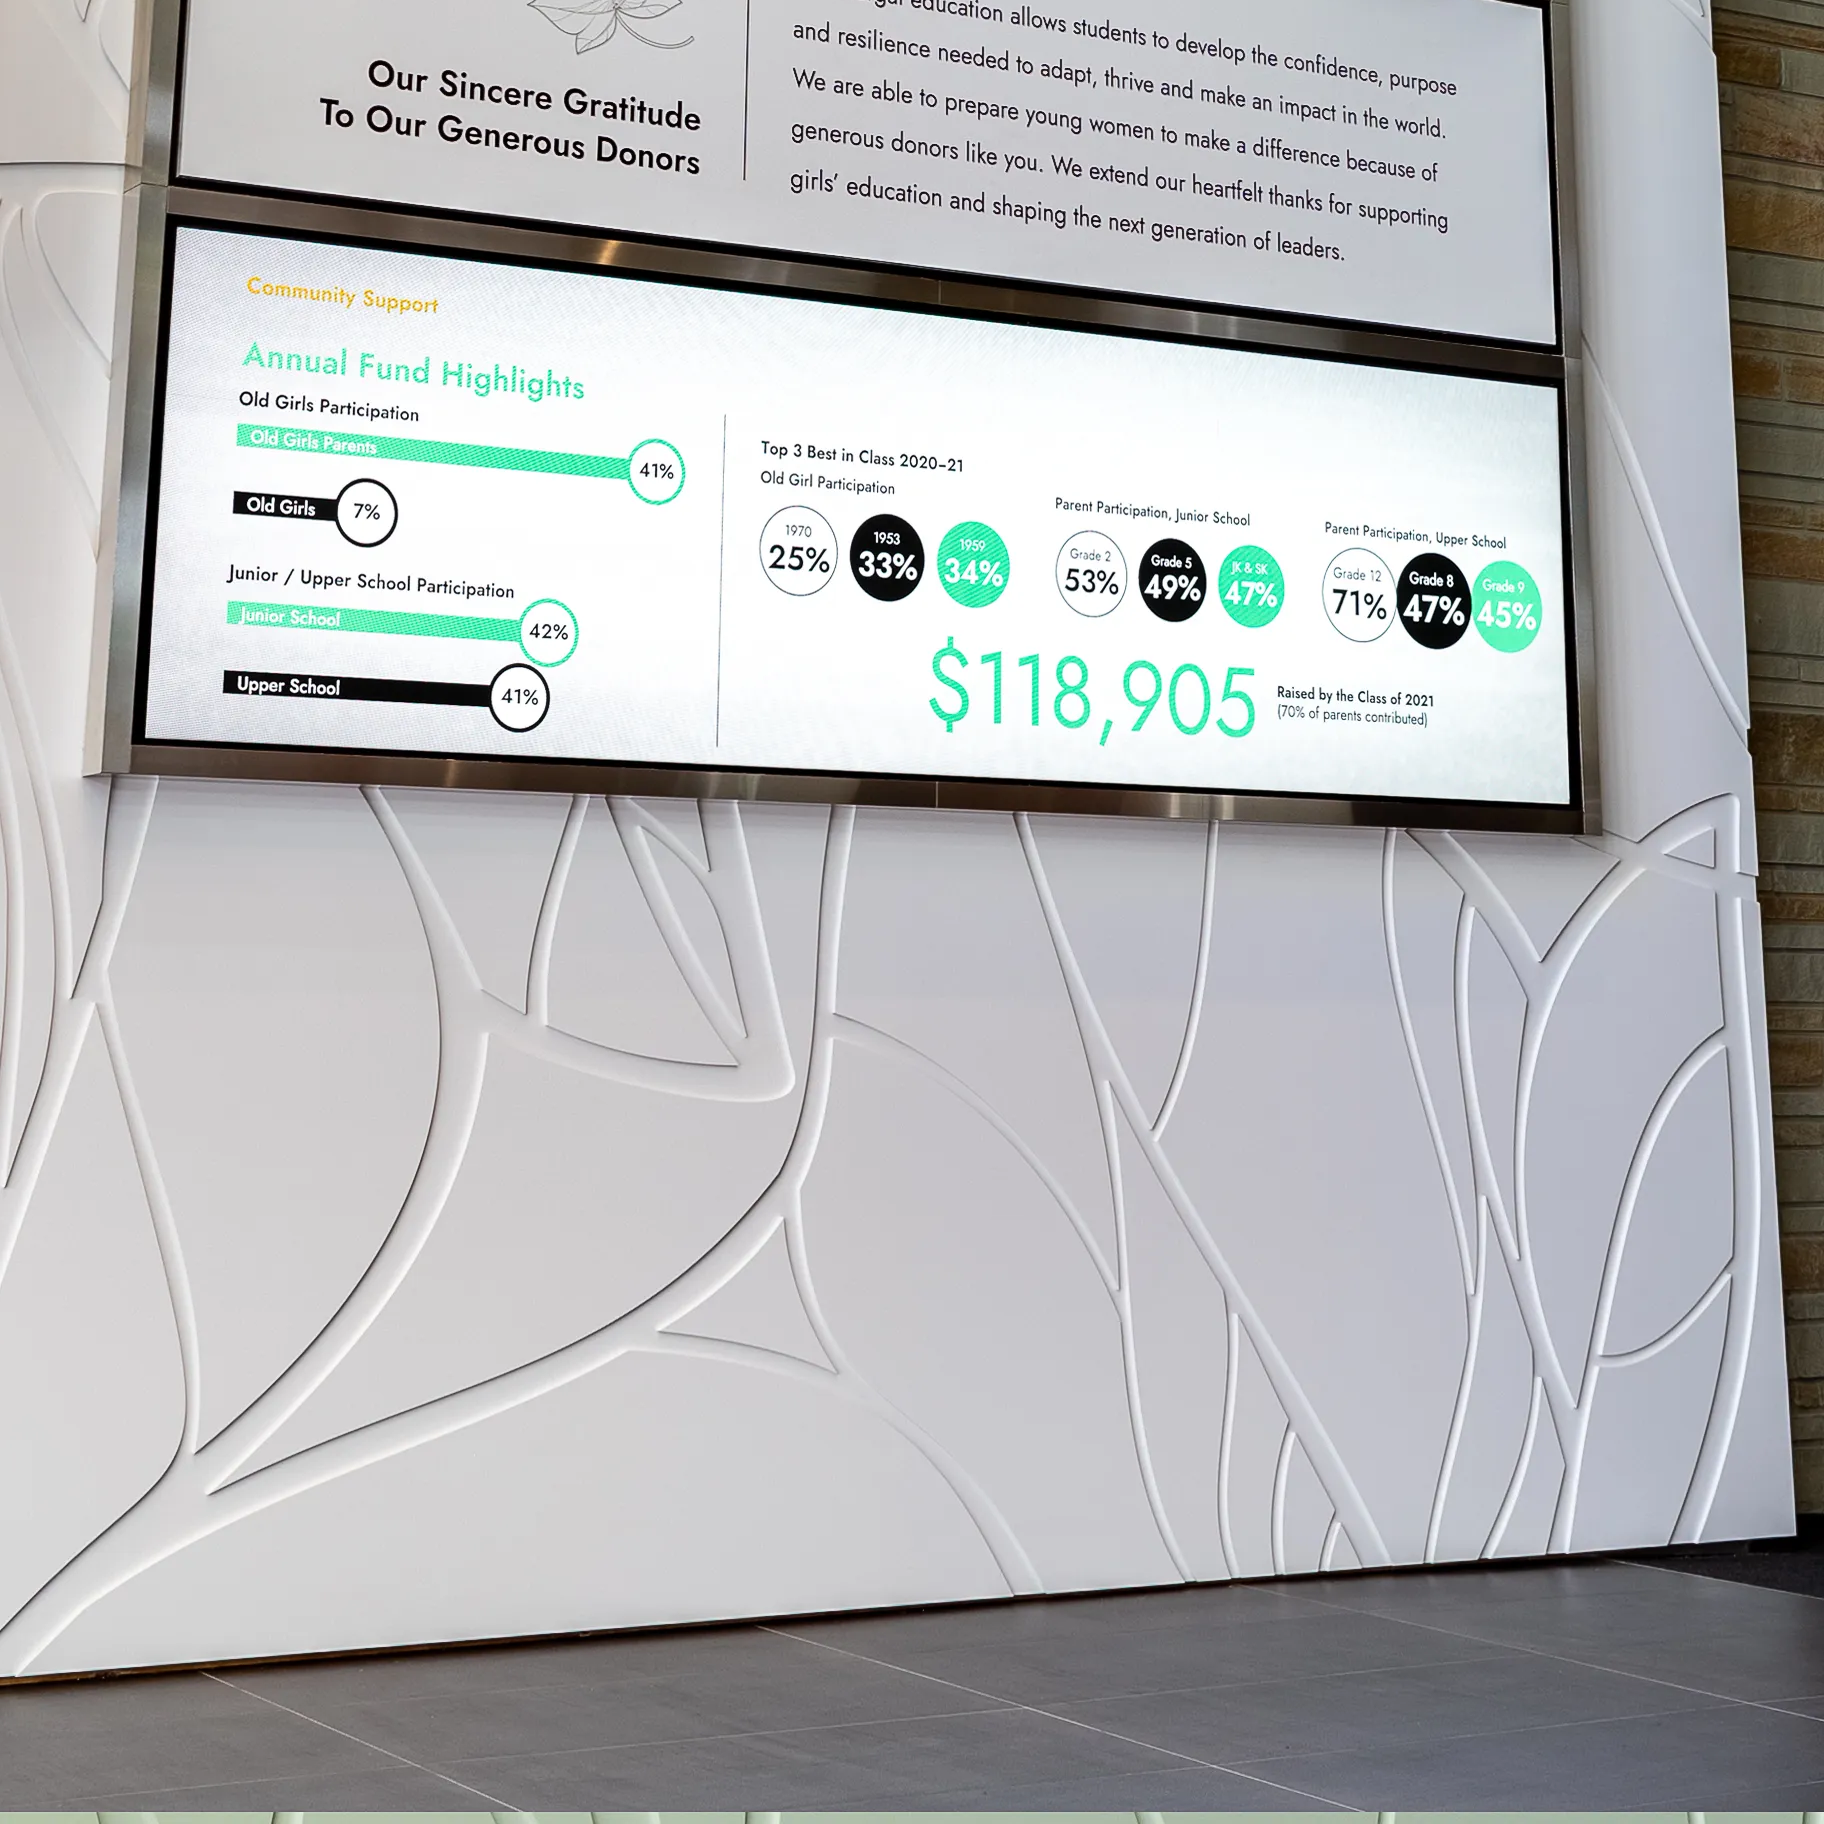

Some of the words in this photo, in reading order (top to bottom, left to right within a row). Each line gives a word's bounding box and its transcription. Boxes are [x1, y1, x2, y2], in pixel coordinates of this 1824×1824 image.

[1011, 6, 1066, 32] allows
[1073, 20, 1146, 45] students
[1152, 31, 1169, 49] to
[1176, 32, 1245, 65] develop
[1252, 45, 1277, 66] the
[1284, 54, 1382, 87] confidence,
[1390, 74, 1456, 95] purpose
[794, 21, 829, 42] and
[839, 29, 930, 57] resilience
[939, 46, 1008, 70] needed
[1016, 56, 1033, 74] to
[1041, 59, 1096, 88] adapt,
[1105, 67, 1154, 93] thrive
[1161, 79, 1193, 99] and
[1201, 85, 1245, 107] make
[1253, 97, 1272, 112] an
[1280, 95, 1336, 122] impact
[1343, 105, 1357, 125] in
[1363, 107, 1388, 129] the
[1395, 117, 1445, 138] world.
[369, 60, 428, 92] Our
[440, 70, 552, 110] Sincere
[564, 88, 700, 130] Gratitude
[320, 98, 354, 127] To
[367, 105, 427, 137] Our
[438, 115, 584, 159] Generous
[597, 136, 699, 174] Donors
[793, 68, 825, 91] We
[834, 80, 864, 96] are
[872, 80, 912, 103] able
[920, 89, 937, 107] to
[946, 97, 1018, 120] prepare
[1026, 109, 1081, 134] young
[1089, 119, 1153, 140] women
[1161, 126, 1177, 143] to
[1185, 129, 1230, 151] make
[1237, 141, 1246, 153] a
[1253, 137, 1340, 167] difference
[1347, 149, 1415, 178] because
[1422, 163, 1438, 182] of
[792, 124, 884, 149] generous
[892, 131, 958, 159] donors
[967, 141, 997, 165] like
[1004, 154, 1043, 173] you.
[1051, 155, 1082, 177] We
[1090, 165, 1148, 186] extend
[1156, 176, 1186, 192] our
[1193, 173, 1263, 203] heartfelt
[1269, 185, 1322, 211] thanks
[1329, 193, 1352, 215] for
[1359, 205, 1448, 233] supporting
[847, 176, 941, 206] education
[950, 192, 984, 212] and
[993, 195, 1066, 229] shaping
[1073, 205, 1101, 228] the
[1109, 217, 1145, 234] next
[1152, 223, 1246, 247] generation
[1254, 231, 1271, 250] of
[1278, 232, 1344, 261] leaders.
[247, 275, 356, 308] Community
[363, 290, 438, 315] Support
[242, 342, 346, 375] Annual
[360, 353, 430, 383] Fund
[443, 361, 584, 402] Highlights
[240, 391, 269, 407] Old
[276, 395, 313, 412] Girls
[320, 399, 418, 421] Participation
[251, 430, 278, 445] Old
[284, 433, 318, 448] Girls
[324, 436, 376, 453] Parents
[762, 441, 788, 459] Top
[794, 444, 801, 457] 3
[808, 445, 836, 460] Best
[842, 448, 853, 462] in
[859, 450, 894, 466] Class
[640, 463, 673, 479] 41%
[761, 471, 784, 484] Old
[789, 473, 812, 487] Girl
[818, 476, 894, 494] Participation
[247, 496, 275, 513] Old
[280, 499, 315, 516] Girls
[354, 503, 380, 520] 7%
[1056, 497, 1092, 511] Parent
[1097, 501, 1171, 521] Participation,
[1175, 508, 1208, 523] Junior
[1213, 512, 1250, 525] School
[786, 525, 811, 537] 1970
[874, 532, 900, 545] 1953
[1326, 522, 1359, 535] Parent
[1363, 525, 1432, 544] Participation,
[1436, 532, 1468, 547] Upper
[1472, 535, 1506, 548] School
[961, 540, 984, 550] 1959
[1070, 548, 1101, 561] Grade
[1105, 551, 1110, 562] 2
[769, 545, 829, 573] 25%
[859, 551, 917, 580] 33%
[1151, 555, 1182, 568] Grade
[1185, 557, 1192, 569] 5
[1230, 560, 1242, 575] JK
[1244, 561, 1252, 574] &
[1255, 563, 1268, 575] SK
[226, 564, 278, 583] Junior
[284, 569, 294, 585] /
[301, 570, 351, 589] Upper
[358, 573, 410, 591] School
[418, 578, 513, 599] Participation
[946, 558, 1002, 586] 34%
[1065, 569, 1118, 595] 53%
[1334, 567, 1365, 580] Grade
[1371, 570, 1381, 582] 12
[1409, 571, 1443, 586] Grade
[1447, 574, 1454, 587] 8
[1144, 574, 1201, 601] 49%
[1226, 581, 1276, 606] 47%
[1482, 578, 1515, 593] Grade
[1517, 581, 1526, 593] 9
[239, 606, 285, 625] Junior
[290, 610, 340, 626] School
[1333, 589, 1386, 619] 71%
[1403, 594, 1464, 625] 47%
[1478, 601, 1536, 630] 45%
[530, 624, 568, 640] 42%
[238, 676, 285, 695] Upper
[290, 678, 340, 696] School
[502, 689, 538, 705] 41%
[929, 636, 1255, 746] $118,905
[1278, 686, 1314, 699] Raised
[1319, 687, 1332, 704] by
[1336, 689, 1353, 701] the
[1358, 690, 1386, 704] Class
[1391, 692, 1401, 704] of
[1406, 694, 1433, 706] 2021
[1278, 704, 1305, 719] (70%
[1309, 706, 1319, 718] of
[1324, 711, 1361, 722] parents
[1365, 711, 1427, 728] contributed)
